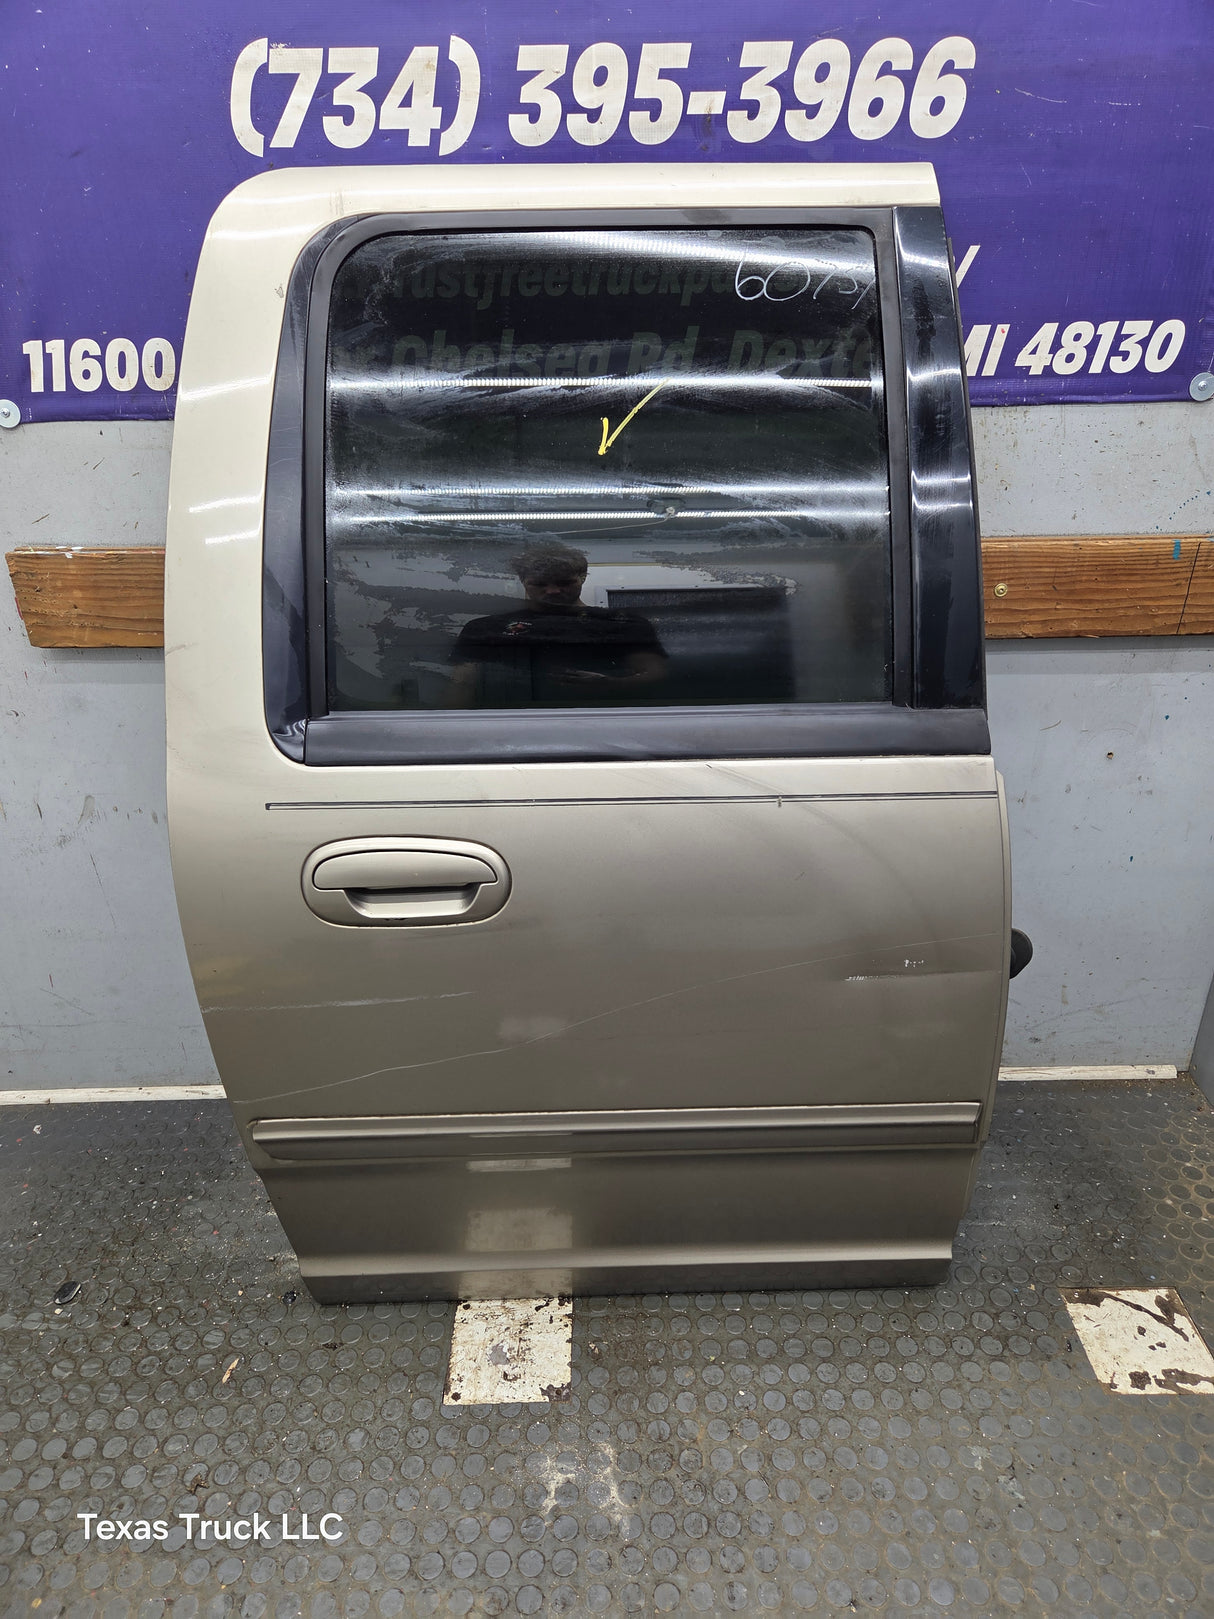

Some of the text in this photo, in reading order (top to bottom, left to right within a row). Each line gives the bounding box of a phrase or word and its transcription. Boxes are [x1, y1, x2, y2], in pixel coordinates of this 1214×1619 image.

[230, 34, 976, 157] (734) 395-3966
[23, 338, 175, 392] 11600
[728, 329, 873, 377] Dexte
[1015, 319, 1186, 376] 48130
